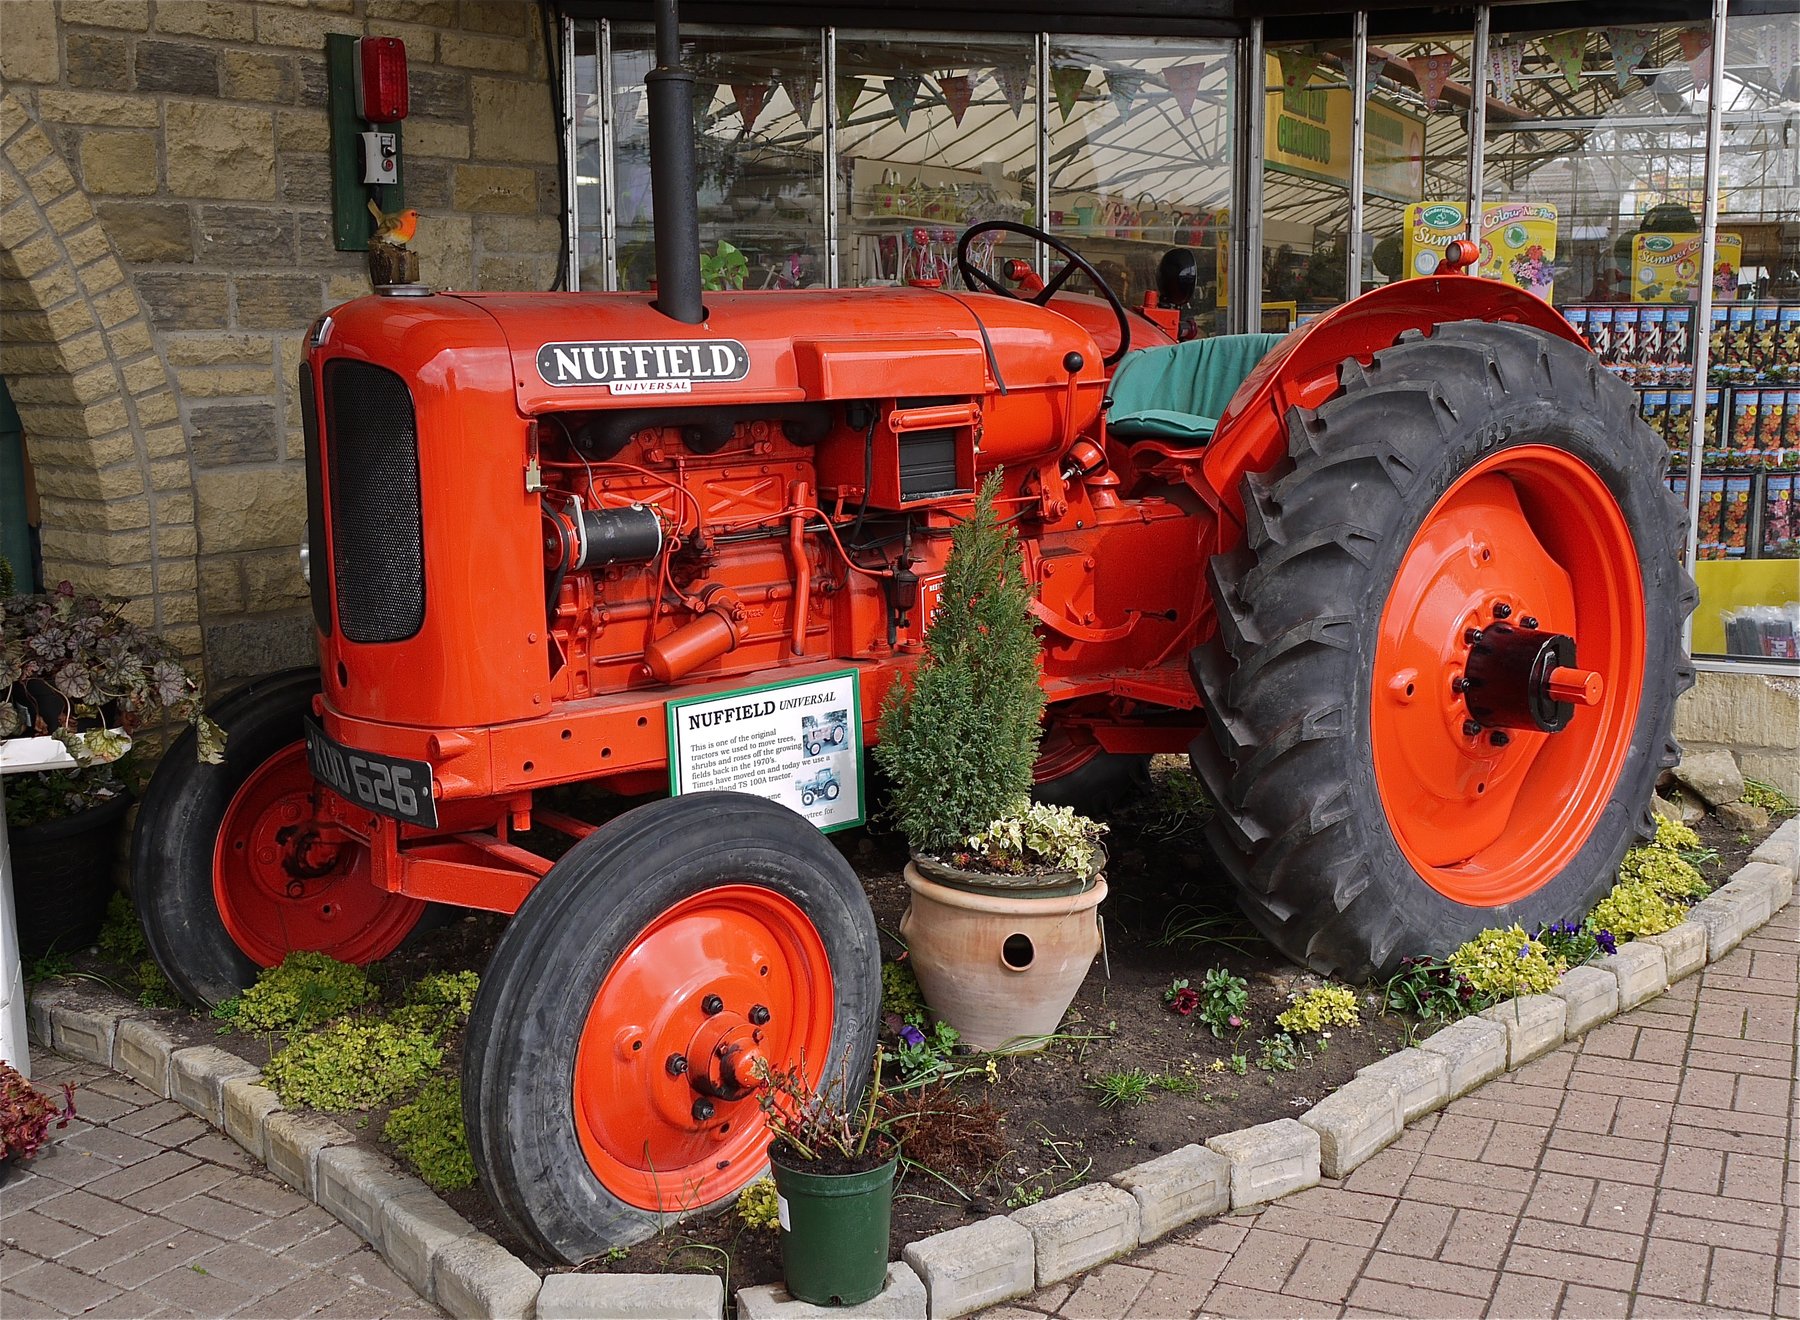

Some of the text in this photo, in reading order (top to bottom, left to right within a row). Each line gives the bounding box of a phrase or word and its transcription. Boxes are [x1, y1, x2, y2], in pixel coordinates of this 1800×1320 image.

[1484, 206, 1522, 228] Colour
[1638, 248, 1688, 264] Summer
[554, 345, 736, 380] NUFFIELD
[614, 382, 688, 392] UNIVERSAL
[688, 691, 836, 730] NUFFIELD UNIVERSAL
[690, 744, 706, 753] This
[716, 739, 728, 747] one
[730, 736, 738, 744] of
[738, 734, 750, 743] the
[750, 728, 777, 740] original
[691, 751, 718, 761] tractors
[732, 744, 748, 753] used
[758, 740, 776, 748] move
[777, 735, 796, 744] trees,
[691, 742, 802, 770] shrubs and roses off the growing
[692, 770, 711, 780] fields
[712, 766, 730, 776] back
[740, 761, 751, 770] the
[753, 756, 777, 768] 1970's.
[310, 730, 418, 816] KDD 626
[692, 780, 714, 790] Times
[715, 776, 732, 785] have
[733, 770, 756, 780] moved
[768, 764, 780, 773] and
[782, 761, 800, 772] today
[812, 756, 824, 764] use
[738, 780, 748, 789] TS
[750, 778, 767, 787] 100A
[768, 772, 793, 782] tractor.
[824, 807, 836, 815] for.
